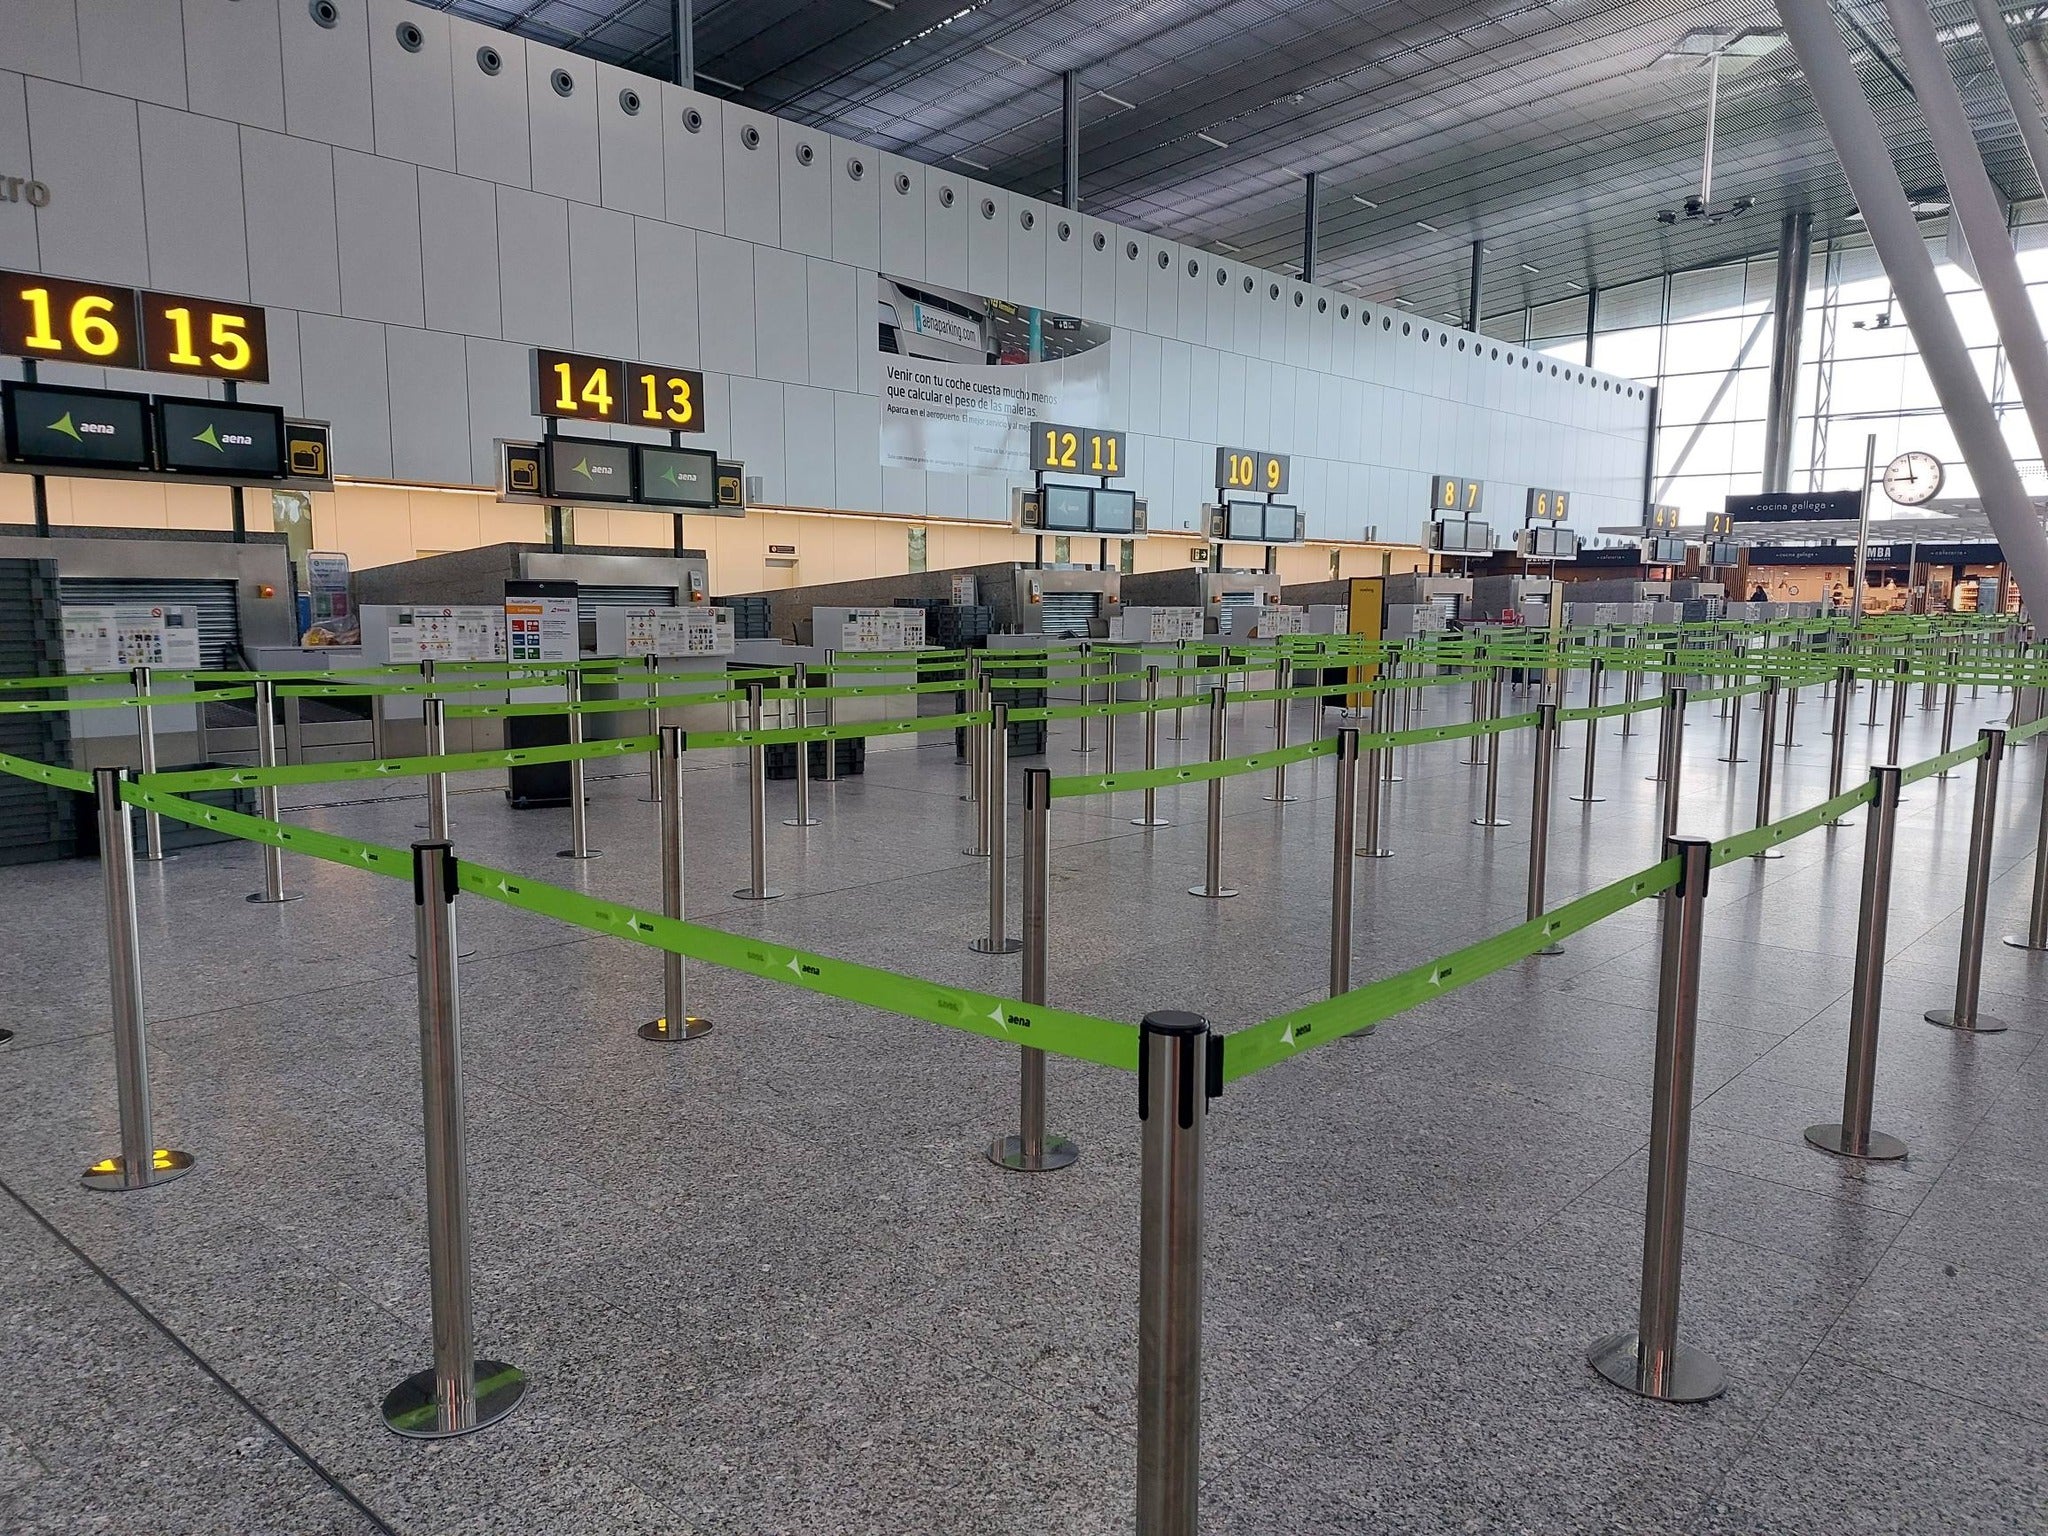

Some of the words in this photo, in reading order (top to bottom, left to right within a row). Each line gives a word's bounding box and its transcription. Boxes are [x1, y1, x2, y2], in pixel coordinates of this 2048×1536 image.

[20, 288, 119, 356] 16
[922, 314, 977, 342] aenaparking.com
[164, 307, 251, 371] 15
[554, 362, 613, 414] 14
[887, 366, 913, 382] Venir
[914, 372, 932, 385] con
[934, 375, 943, 387] tu
[945, 376, 971, 392] coche
[973, 382, 1001, 396] cuesta
[1002, 385, 1029, 400] mucho
[1031, 391, 1058, 405] menos
[641, 374, 692, 423] 13
[887, 385, 906, 399] que
[907, 387, 943, 404] calcular
[945, 393, 953, 405] el
[955, 397, 976, 409] peso
[978, 398, 989, 410] de
[990, 399, 1003, 412] las
[1004, 402, 1038, 418] maletas.
[887, 403, 909, 416] Aparca
[910, 408, 919, 416] en
[919, 408, 926, 417] el
[962, 414, 968, 423] El
[79, 422, 116, 435] aena
[221, 433, 252, 445] aena
[1046, 430, 1078, 468] 12
[1091, 436, 1118, 471] 11
[591, 465, 613, 475] aena
[677, 472, 697, 482] aena
[1229, 454, 1253, 486] 10
[1267, 459, 1280, 489] 9
[1445, 481, 1455, 506] 8
[1468, 484, 1477, 508] 7
[1537, 493, 1546, 515] 6
[1556, 495, 1564, 517] 5
[1656, 508, 1664, 526] 4
[1756, 501, 1788, 511] cocina
[1791, 499, 1827, 513] gallega
[1669, 510, 1677, 528] 3
[1713, 515, 1719, 533] 2
[1725, 516, 1730, 534] 1
[1853, 547, 1891, 558] SMBA
[802, 964, 820, 976] aena
[1007, 1014, 1031, 1028] aena
